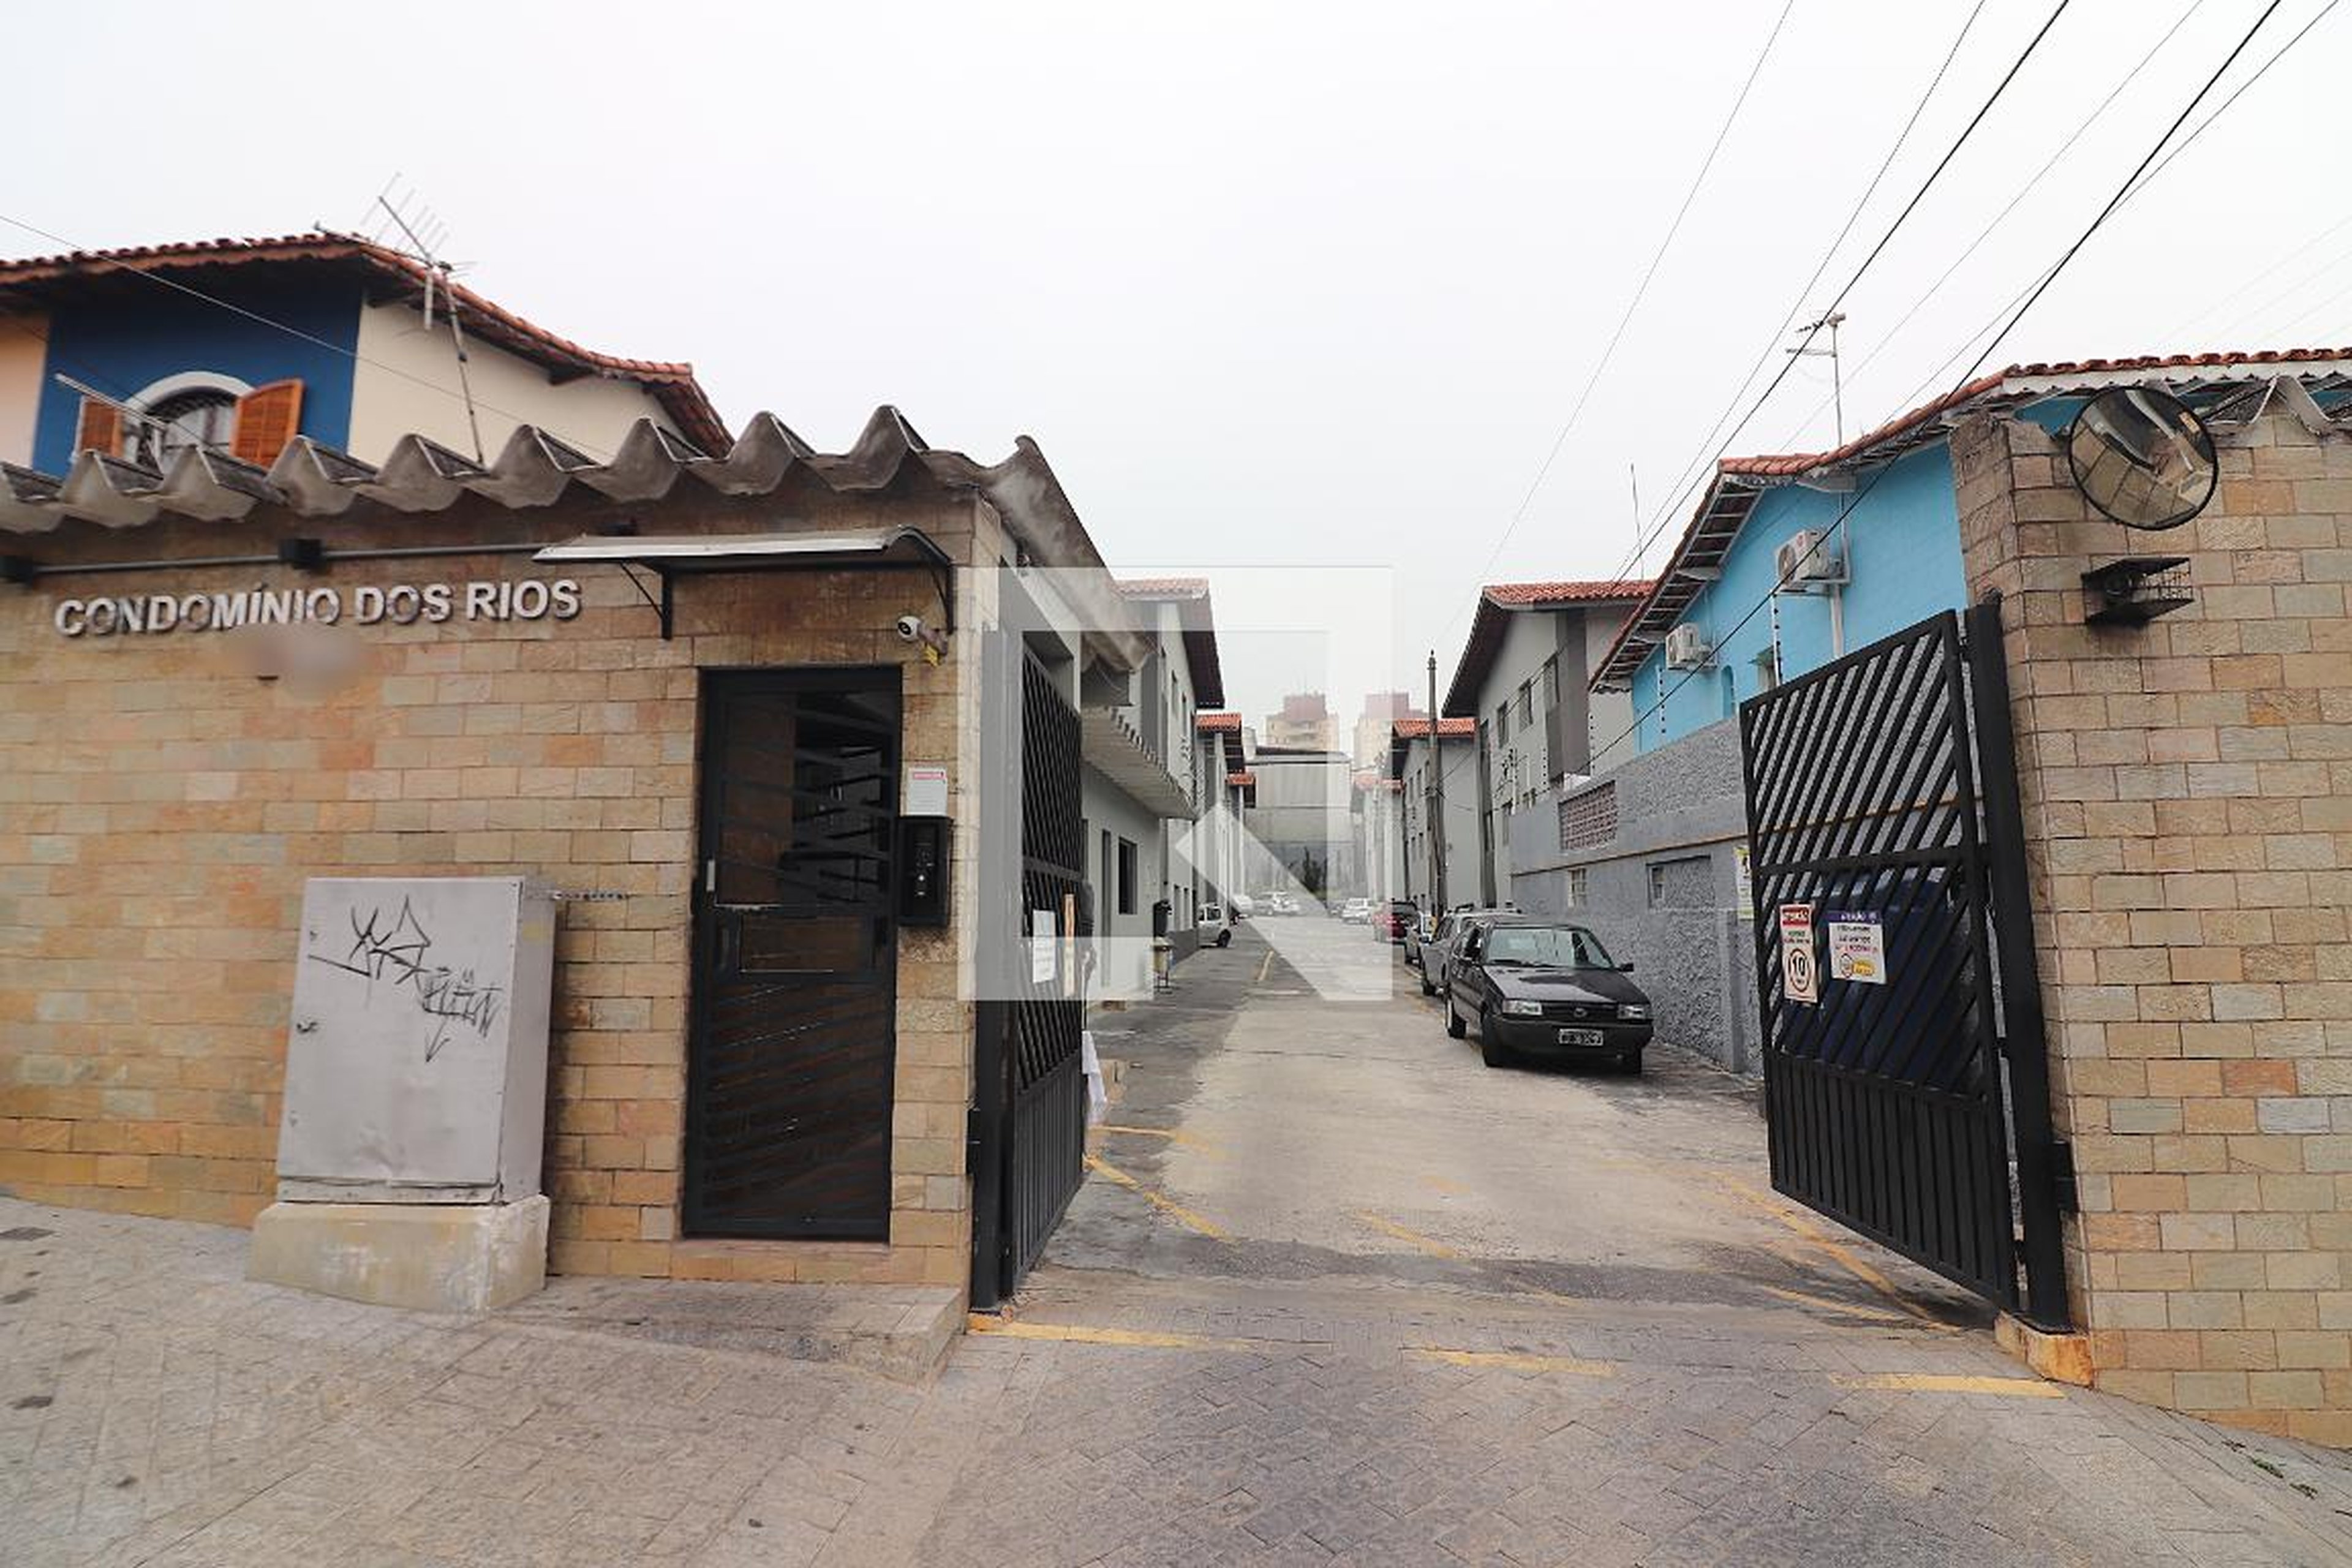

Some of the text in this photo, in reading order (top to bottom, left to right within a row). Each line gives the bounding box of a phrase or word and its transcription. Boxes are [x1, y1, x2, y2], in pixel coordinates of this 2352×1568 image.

[55, 579, 582, 637] CONDOMÍNIO DOS RIOS
[1792, 956, 1806, 976] 10
